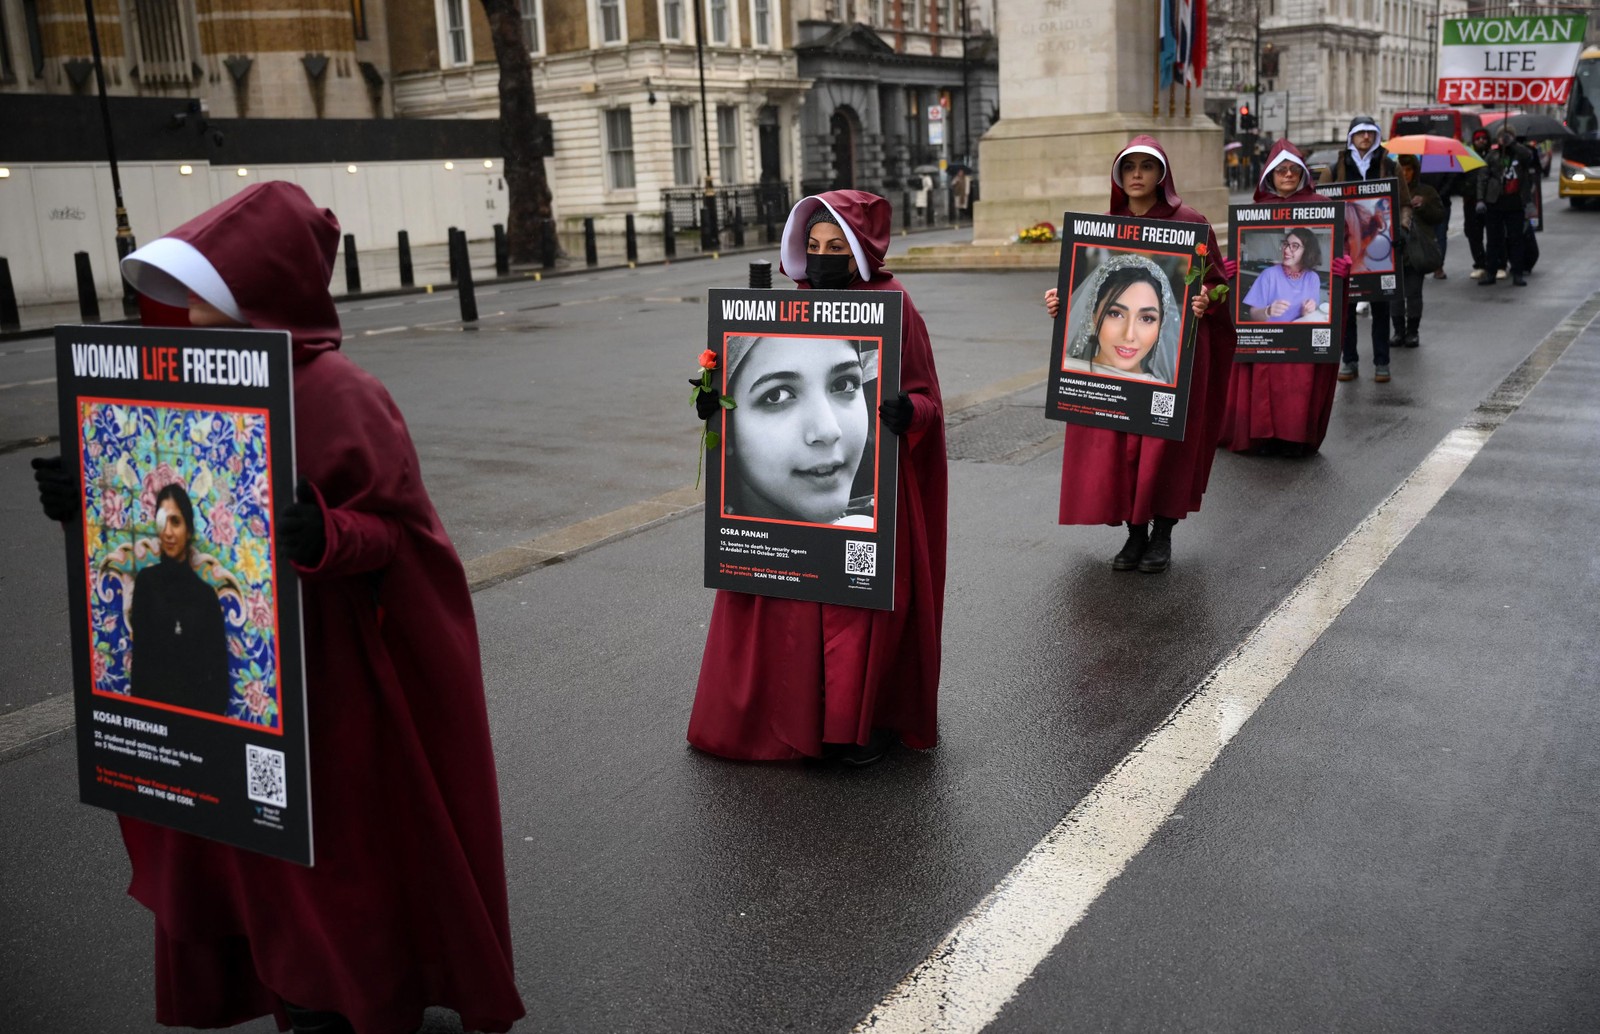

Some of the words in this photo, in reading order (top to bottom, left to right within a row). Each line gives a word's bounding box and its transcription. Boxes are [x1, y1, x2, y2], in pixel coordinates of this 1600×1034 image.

[1457, 18, 1574, 42] WOMAN
[1484, 51, 1536, 72] LIFE
[1443, 79, 1569, 102] FREEDOM
[1343, 185, 1357, 195] LIFE
[1358, 182, 1391, 195] FREEDOM
[1236, 209, 1271, 221] WOMAN
[1272, 208, 1291, 220] LIFE
[1292, 207, 1335, 219] FREEDOM
[1073, 220, 1116, 238] WOMAN
[1117, 224, 1141, 240] LIFE
[1141, 226, 1196, 246] FREEDOM
[722, 299, 776, 322] WOMAN
[779, 300, 810, 322] LIFE
[813, 301, 884, 325] FREEDOM
[72, 344, 138, 380] WOMAN
[142, 347, 180, 382] LIFE
[182, 348, 270, 388] FREEDOM
[1060, 378, 1086, 386] HANANEH
[1087, 381, 1121, 391] KIAKOJOORI
[720, 528, 739, 536] OSRA
[741, 530, 768, 539] PANAHI
[93, 710, 122, 727] KOSAR
[124, 717, 168, 736] EFTEKHARI
